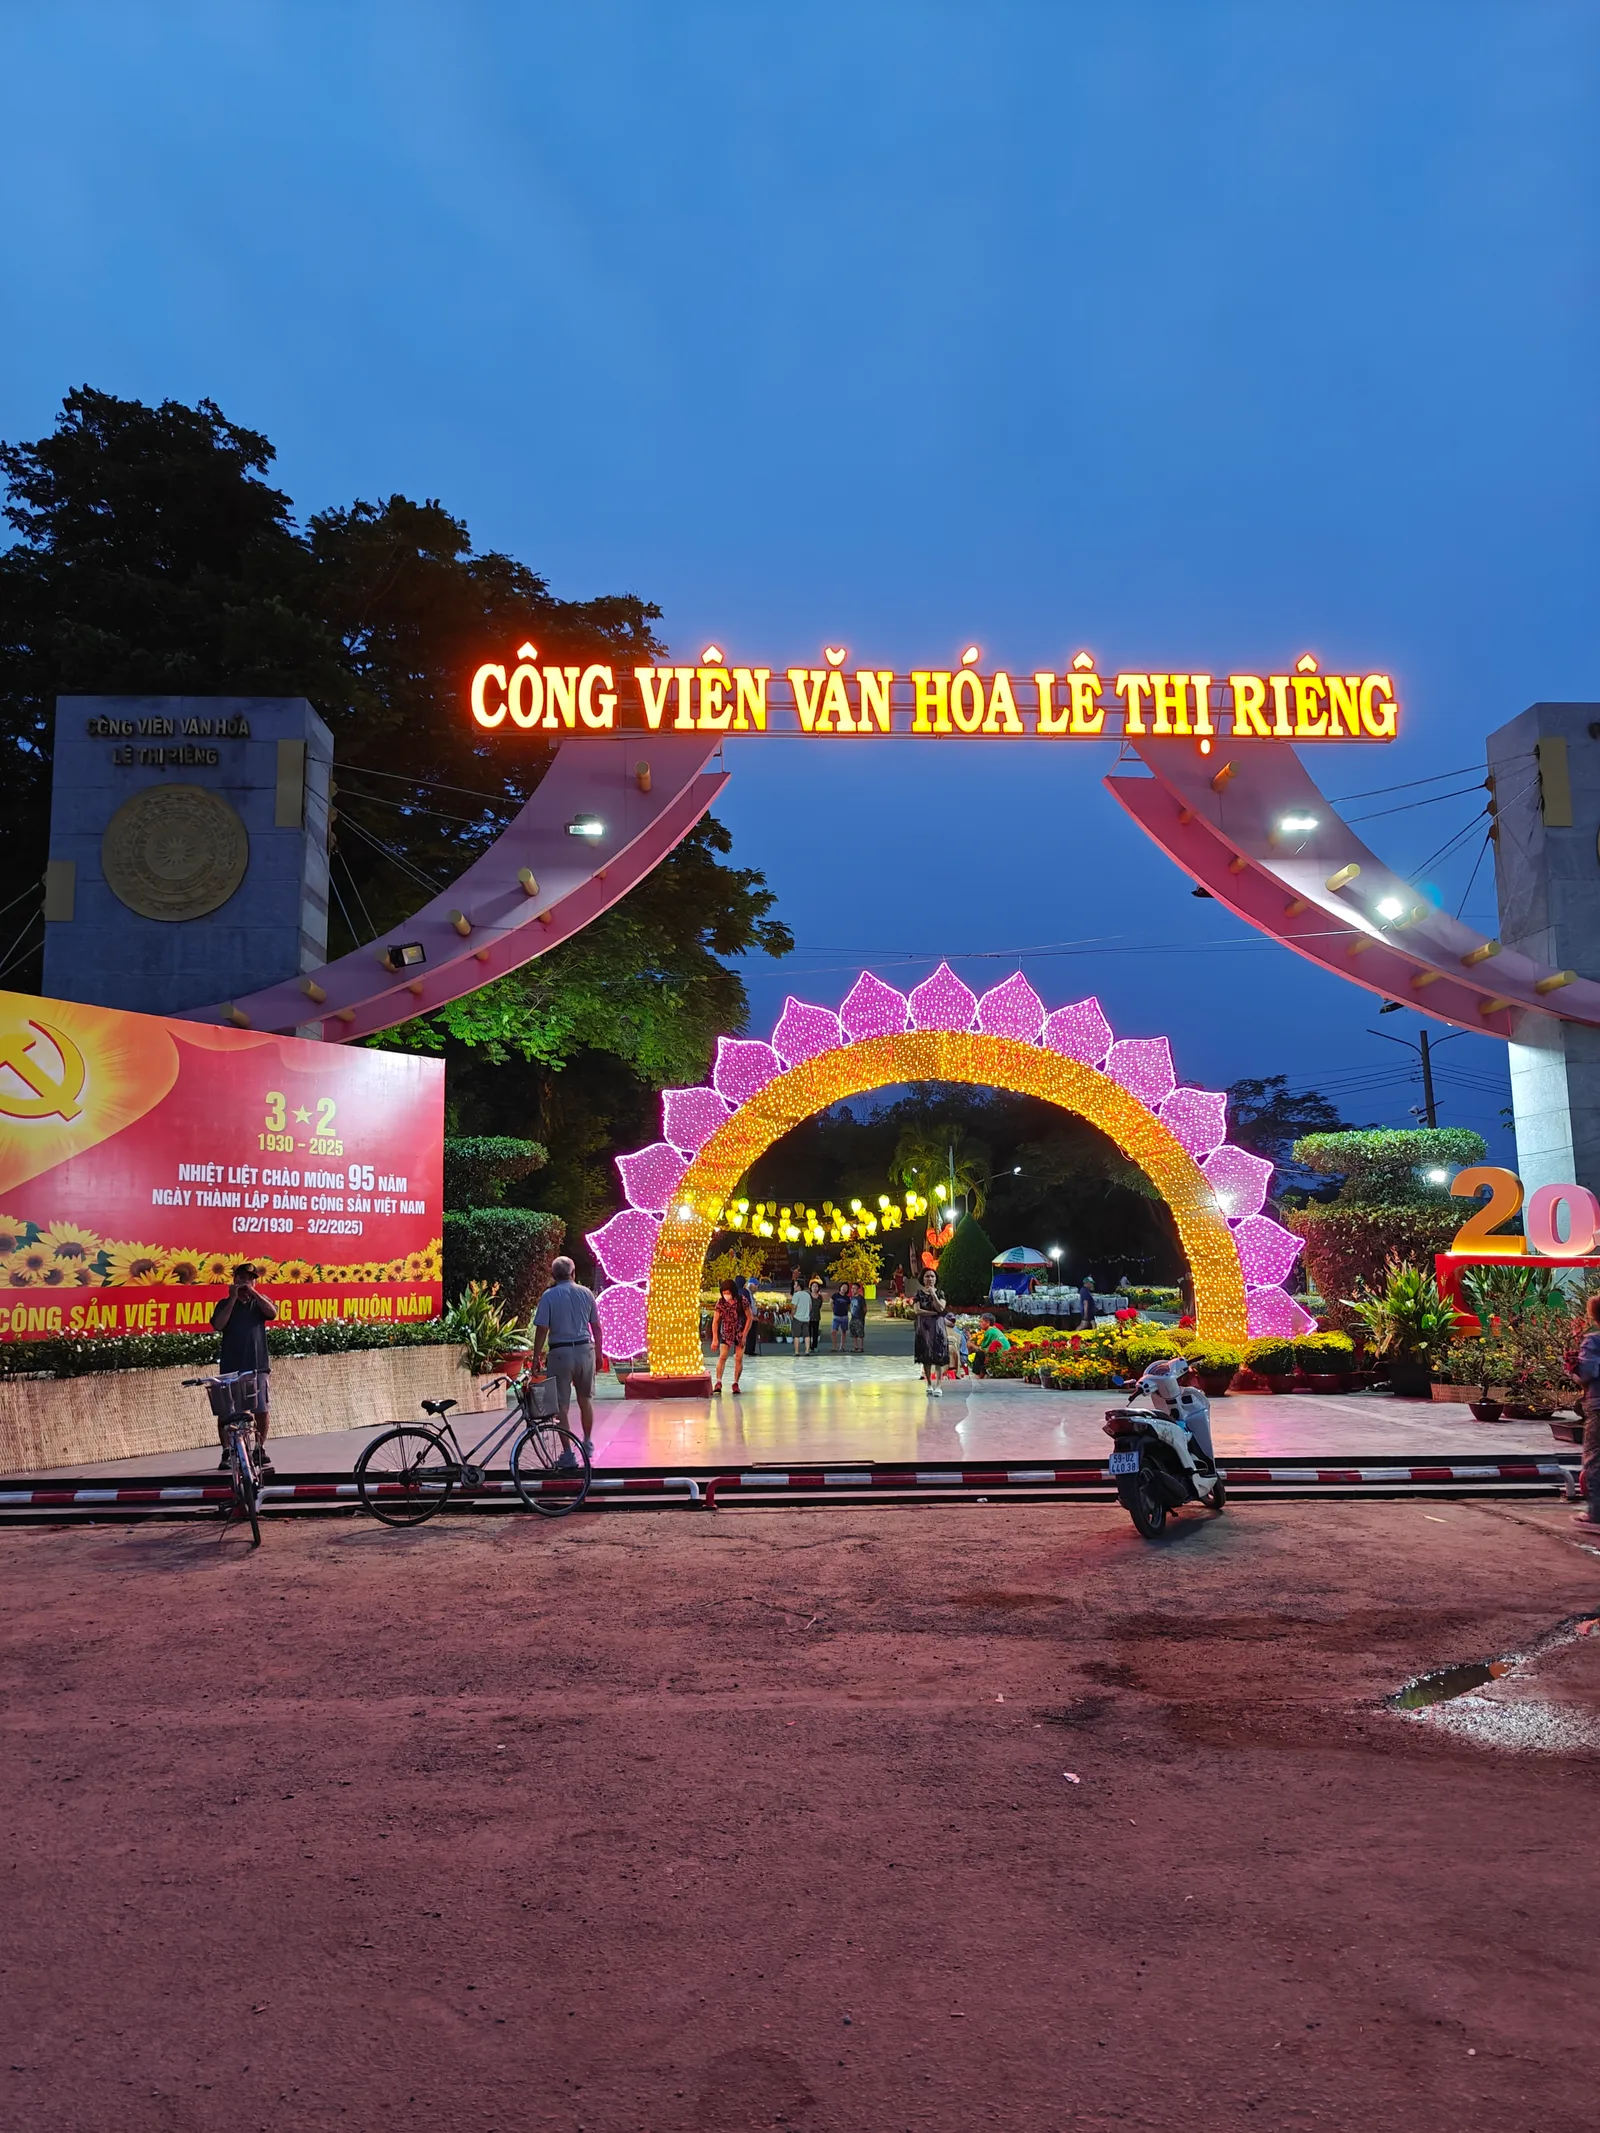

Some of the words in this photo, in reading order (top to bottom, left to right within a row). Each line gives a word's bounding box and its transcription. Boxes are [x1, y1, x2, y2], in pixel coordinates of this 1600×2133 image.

[470, 641, 618, 729] CÔNG
[633, 644, 771, 731] VIÊN
[786, 645, 894, 733] VĂN
[910, 645, 1024, 734] HÓA
[1033, 650, 1105, 734] LÊ
[1228, 653, 1398, 737] RIÊNG
[265, 1091, 286, 1132] 3
[316, 1097, 336, 1137] 2
[257, 1133, 294, 1153] 1930
[308, 1137, 344, 1157] 2025
[178, 1162, 224, 1187] NHIỆT
[228, 1164, 259, 1187] LIỆT
[262, 1166, 301, 1188] CHÀO
[303, 1169, 345, 1190] MỪNG
[348, 1164, 375, 1192] 95
[378, 1173, 408, 1193] NĂM
[152, 1187, 194, 1206] NGÀY
[196, 1189, 241, 1208] THÀNH
[244, 1191, 269, 1212] LẬP
[272, 1190, 307, 1211] ĐẢNG
[310, 1193, 344, 1215] CỘNG
[347, 1192, 371, 1214] SẢN
[374, 1196, 398, 1217] VIỆT
[400, 1200, 426, 1215] NAM
[1450, 1166, 1600, 1257] 20
[232, 1216, 294, 1233] (3/2/1930
[307, 1219, 363, 1236] 3/2/2025)
[69, 1297, 117, 1330] SẢN
[124, 1298, 171, 1333] VIỆT
[297, 1298, 339, 1319] VINH
[343, 1293, 392, 1318] MUÔN
[397, 1292, 433, 1316] NĂM
